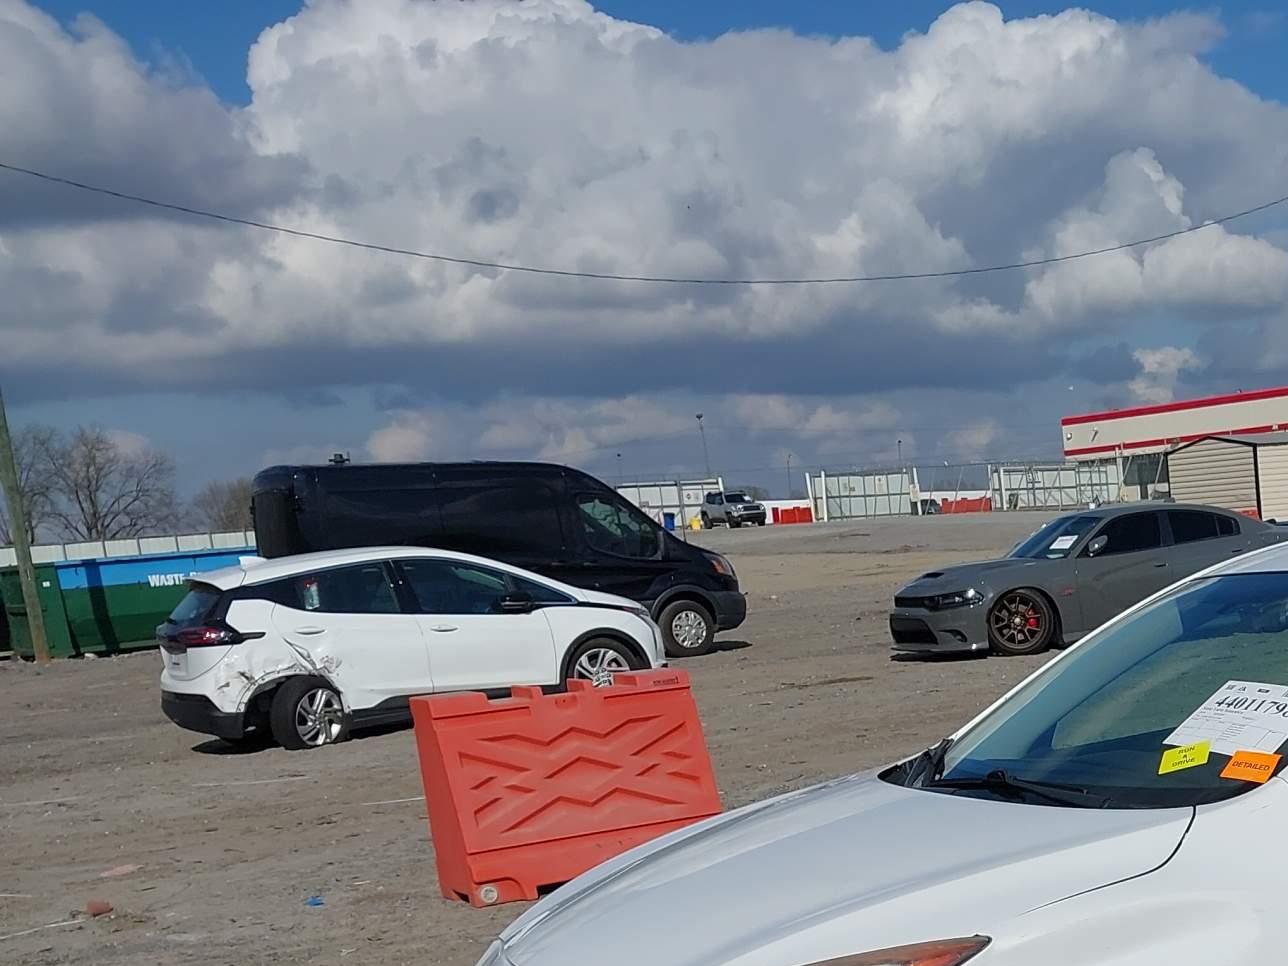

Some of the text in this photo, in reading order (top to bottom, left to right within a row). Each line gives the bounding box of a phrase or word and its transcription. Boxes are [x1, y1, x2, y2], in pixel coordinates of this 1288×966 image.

[1178, 746, 1196, 754] RUN
[1172, 758, 1195, 767] DRIVE
[1232, 761, 1271, 771] DETAILED
